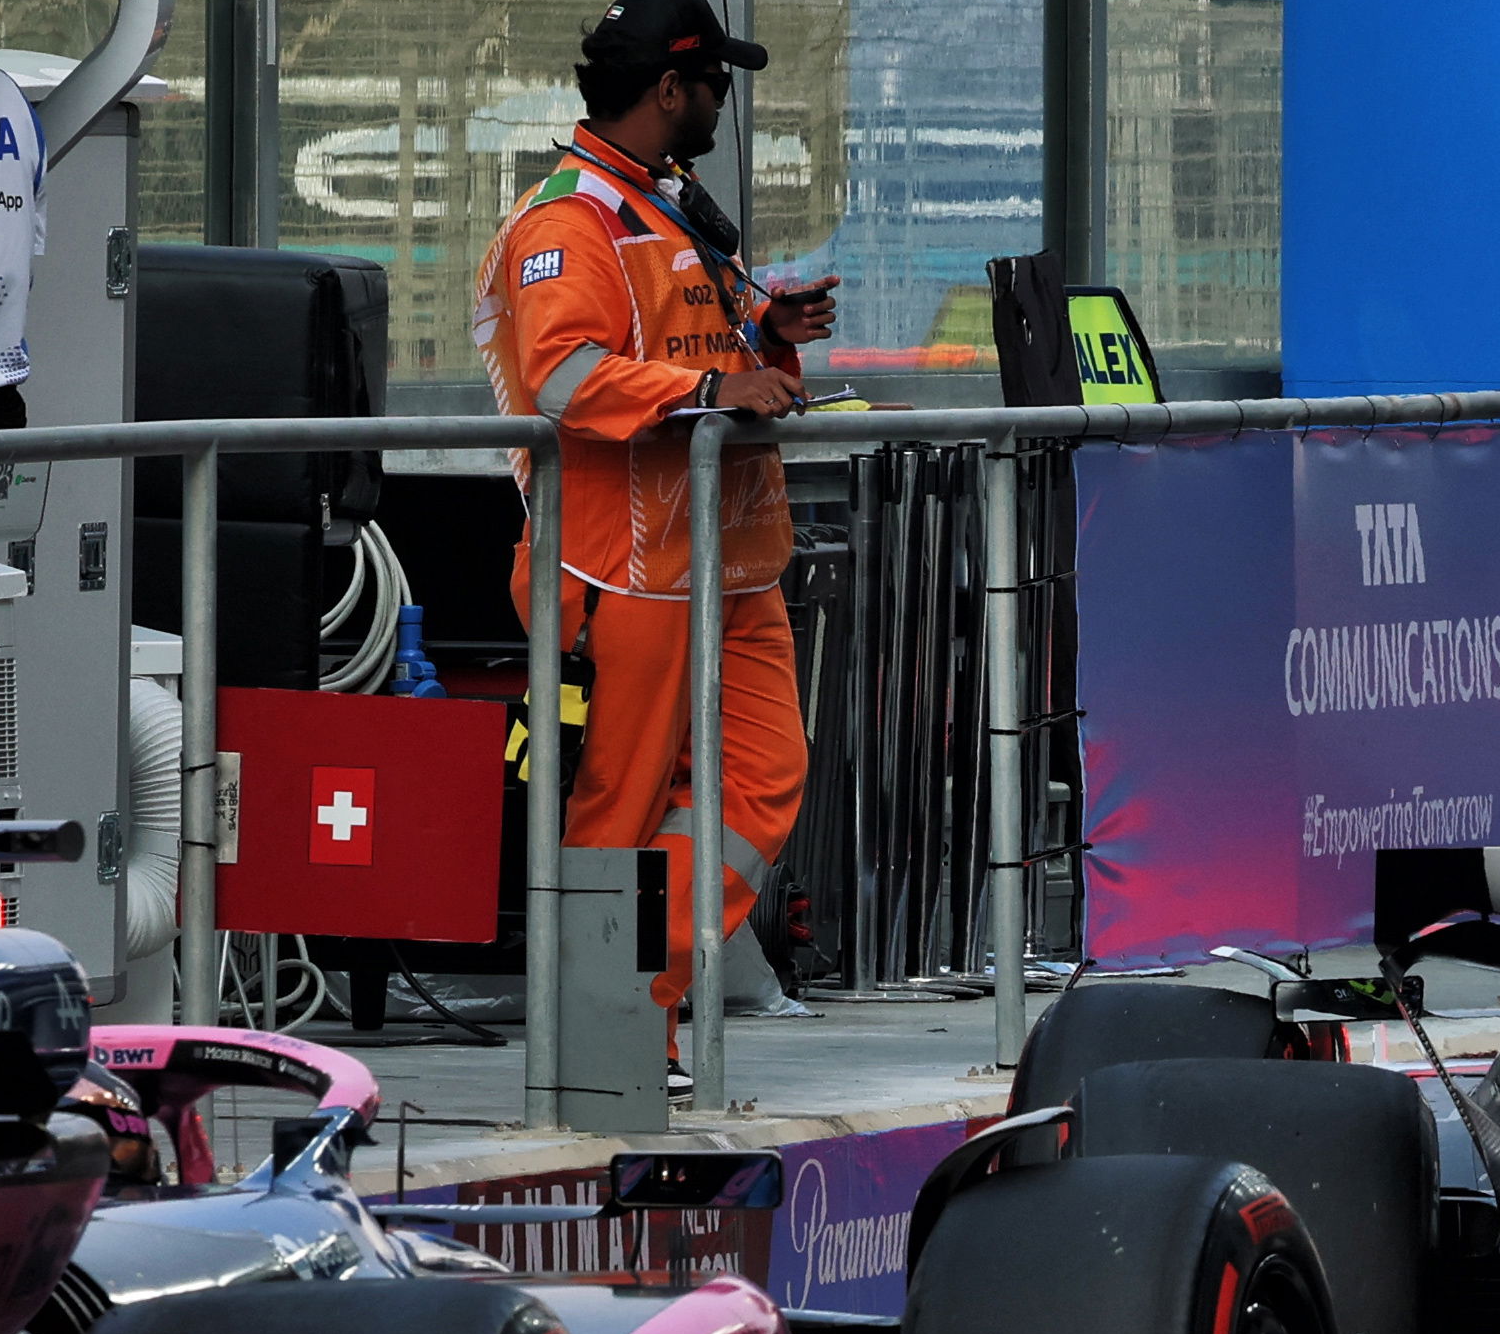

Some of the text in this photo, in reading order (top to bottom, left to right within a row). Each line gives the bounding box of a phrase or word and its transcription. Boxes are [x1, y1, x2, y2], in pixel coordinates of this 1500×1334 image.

[522, 269, 560, 285] SERIES
[523, 251, 561, 277] 24H
[666, 335, 700, 359] PIT
[1075, 331, 1143, 385] ALEX
[1354, 503, 1427, 587] TATA
[1302, 784, 1494, 857] #EmpoweringTomorrow
[113, 1048, 155, 1065] BWT
